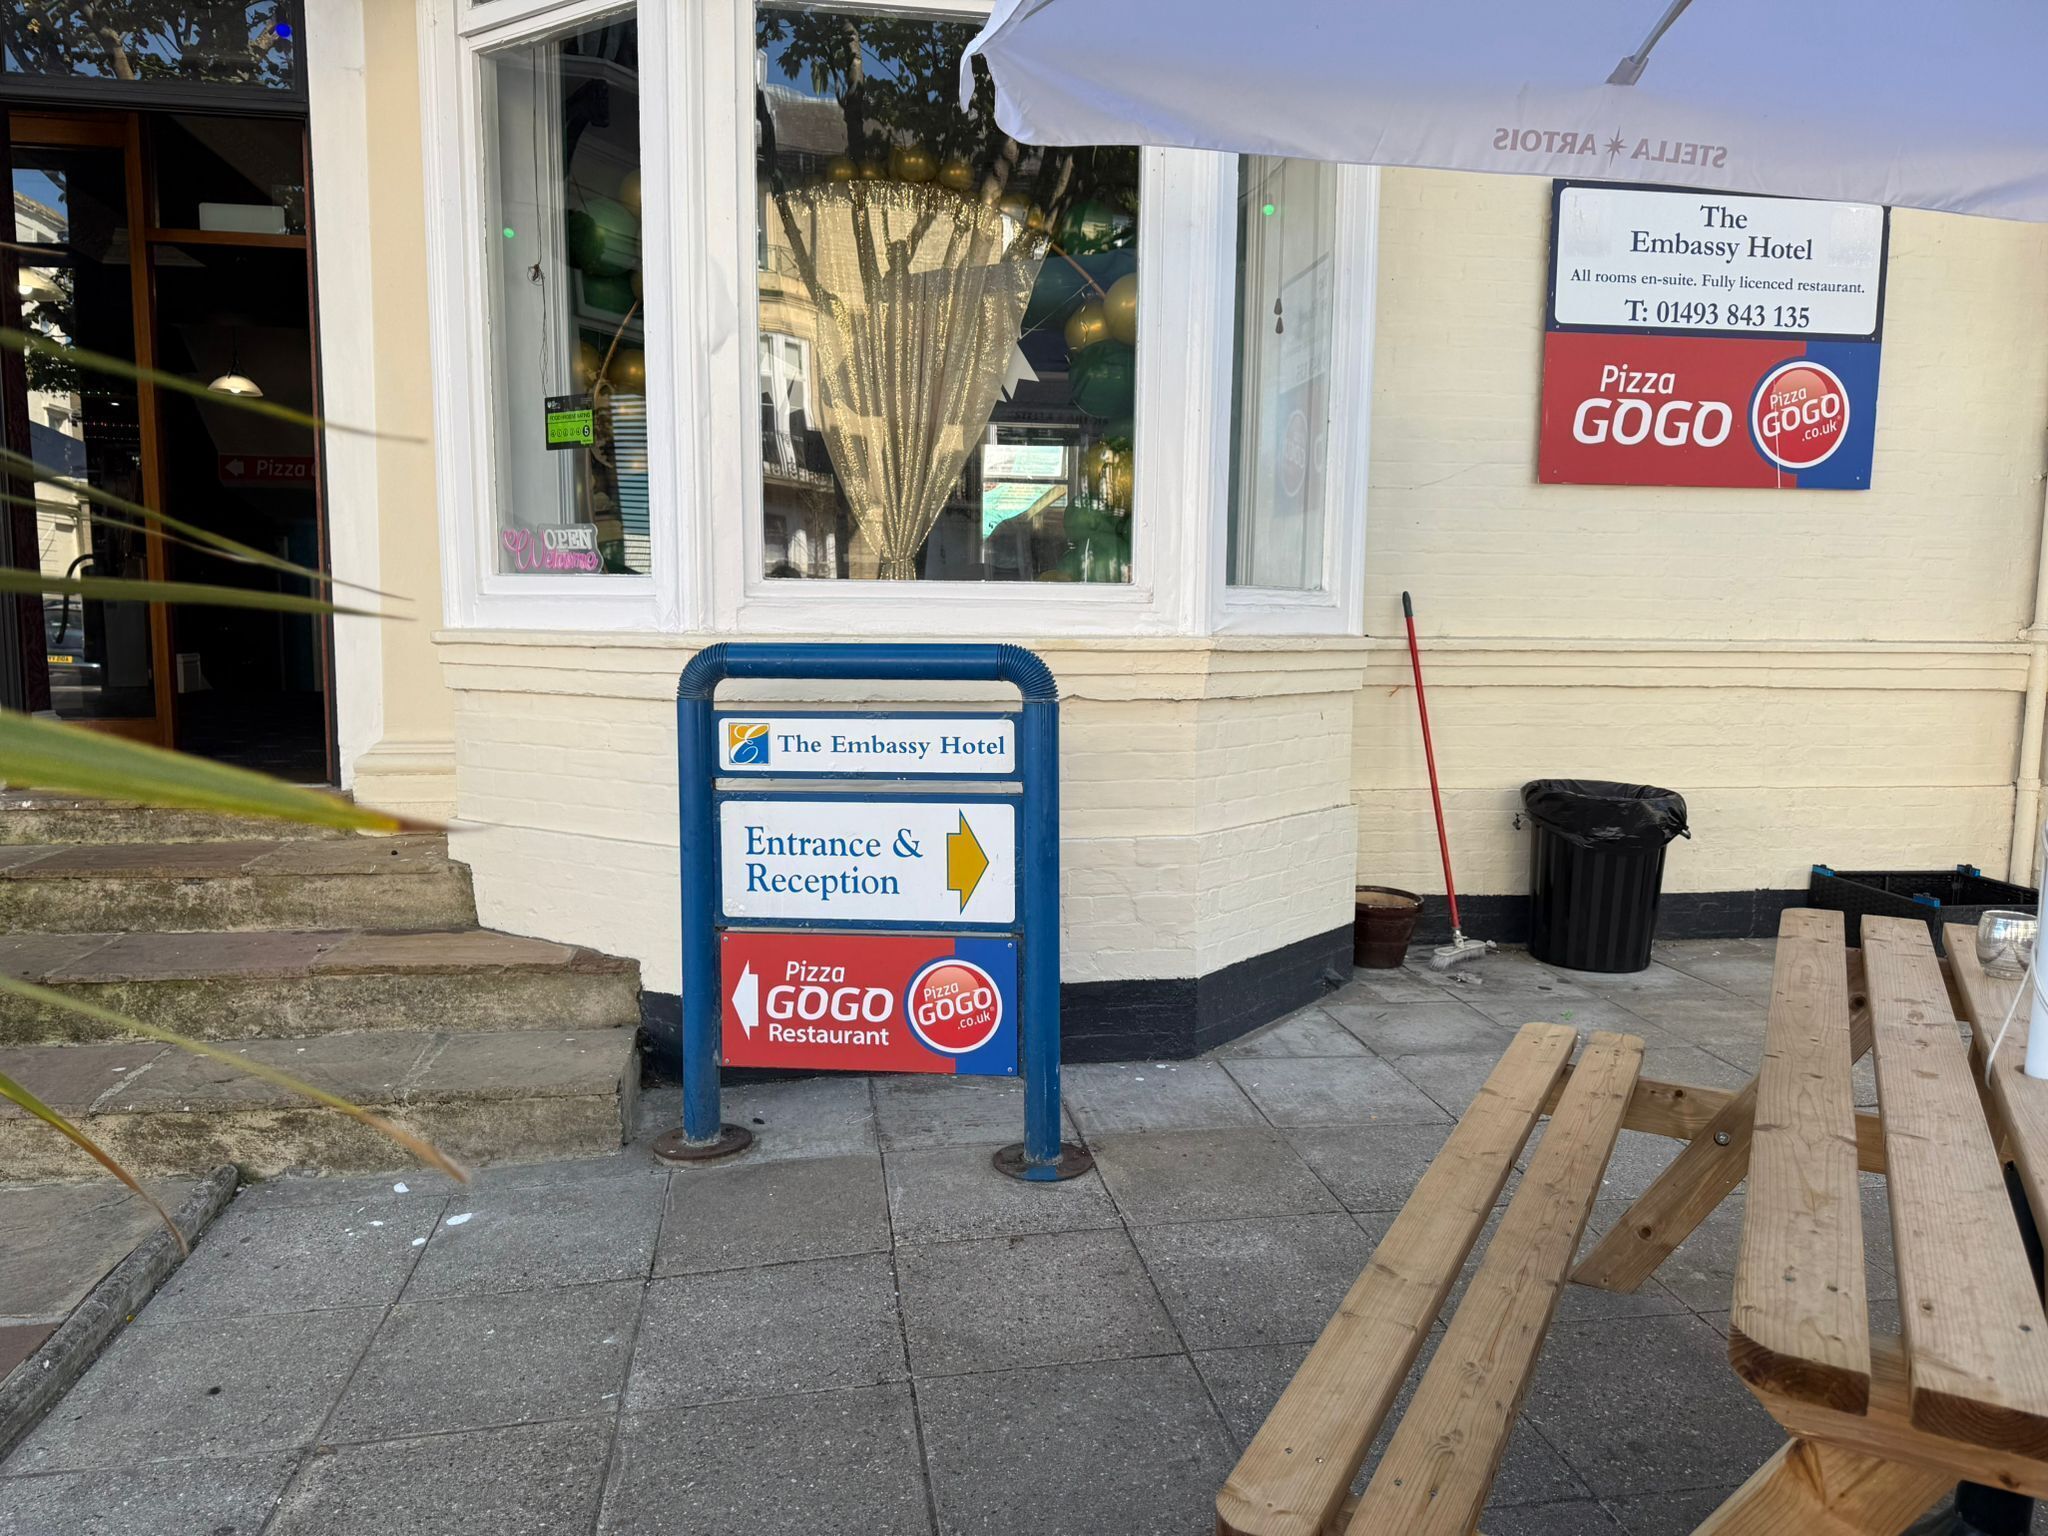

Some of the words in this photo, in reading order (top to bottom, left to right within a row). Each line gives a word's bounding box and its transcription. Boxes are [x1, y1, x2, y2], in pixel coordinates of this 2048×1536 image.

[1700, 204, 1748, 230] The
[1629, 230, 1741, 263] Embassy
[1747, 236, 1813, 261] Hotel
[1570, 268, 1591, 282] All
[1595, 273, 1637, 285] rooms
[1641, 273, 1697, 288] en-suite.
[1702, 274, 1736, 292] Fully
[1739, 276, 1794, 292] licenced
[1797, 280, 1865, 294] restaurant.
[1624, 300, 1648, 323] T:
[1656, 300, 1719, 325] 01493
[1726, 303, 1766, 327] 843
[1774, 306, 1810, 329] 135
[1600, 364, 1676, 395] Pizza
[1769, 386, 1807, 410] Pizza
[1572, 397, 1733, 448] GOGO
[1762, 392, 1840, 438] GOGO
[1800, 418, 1838, 442] .co.uk
[257, 459, 305, 477] Pizza
[513, 528, 599, 572] Welcome
[544, 528, 592, 550] OPEN
[777, 734, 822, 754] The
[831, 734, 930, 759] Embassy
[940, 735, 1005, 755] Hotel
[744, 825, 881, 858] Entrance
[892, 828, 924, 858] &
[745, 863, 900, 901] Reception
[785, 960, 845, 982] Pizza
[766, 985, 894, 1022] GOGO
[923, 982, 959, 1001] Pizza
[918, 987, 993, 1026] GOGO
[769, 1023, 889, 1046] Restaurant
[957, 1013, 991, 1030] .co.uk
